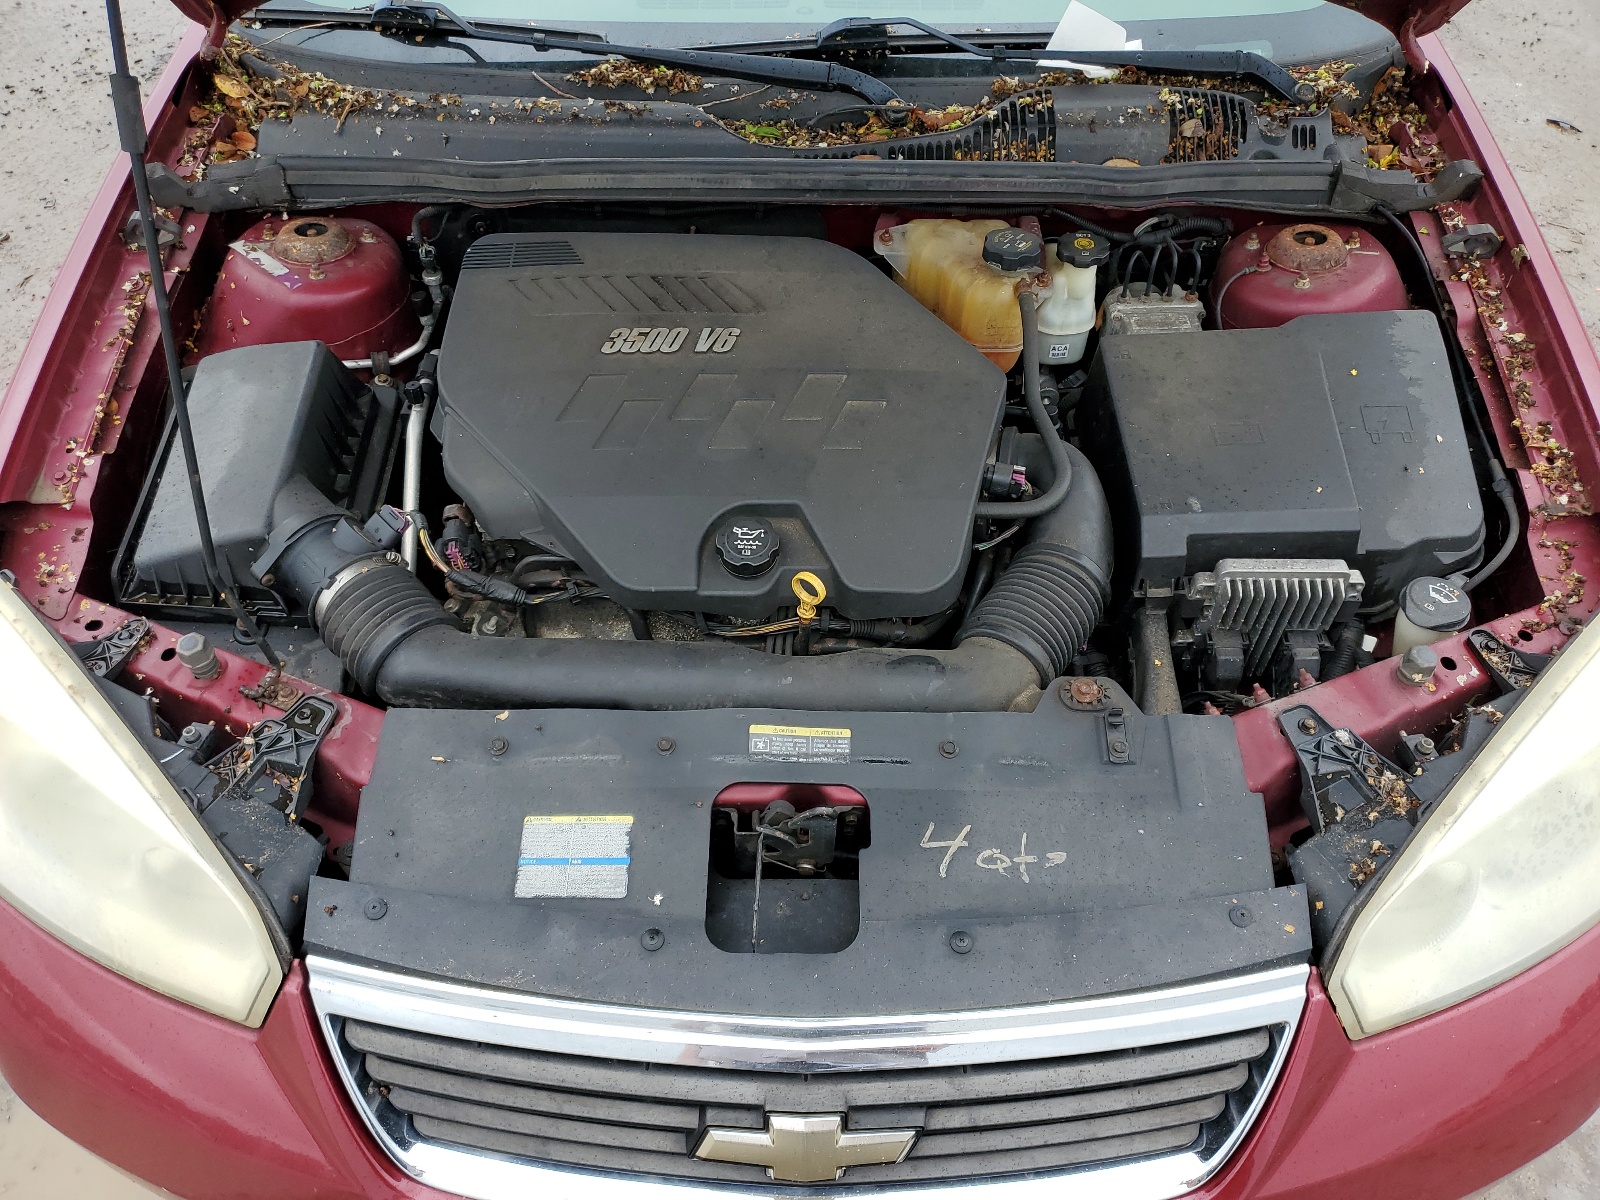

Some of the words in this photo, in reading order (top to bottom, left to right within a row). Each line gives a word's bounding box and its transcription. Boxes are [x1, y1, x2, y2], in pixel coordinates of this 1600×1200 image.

[600, 327, 690, 354] 3500
[694, 327, 741, 353] V6
[920, 821, 972, 878] 4
